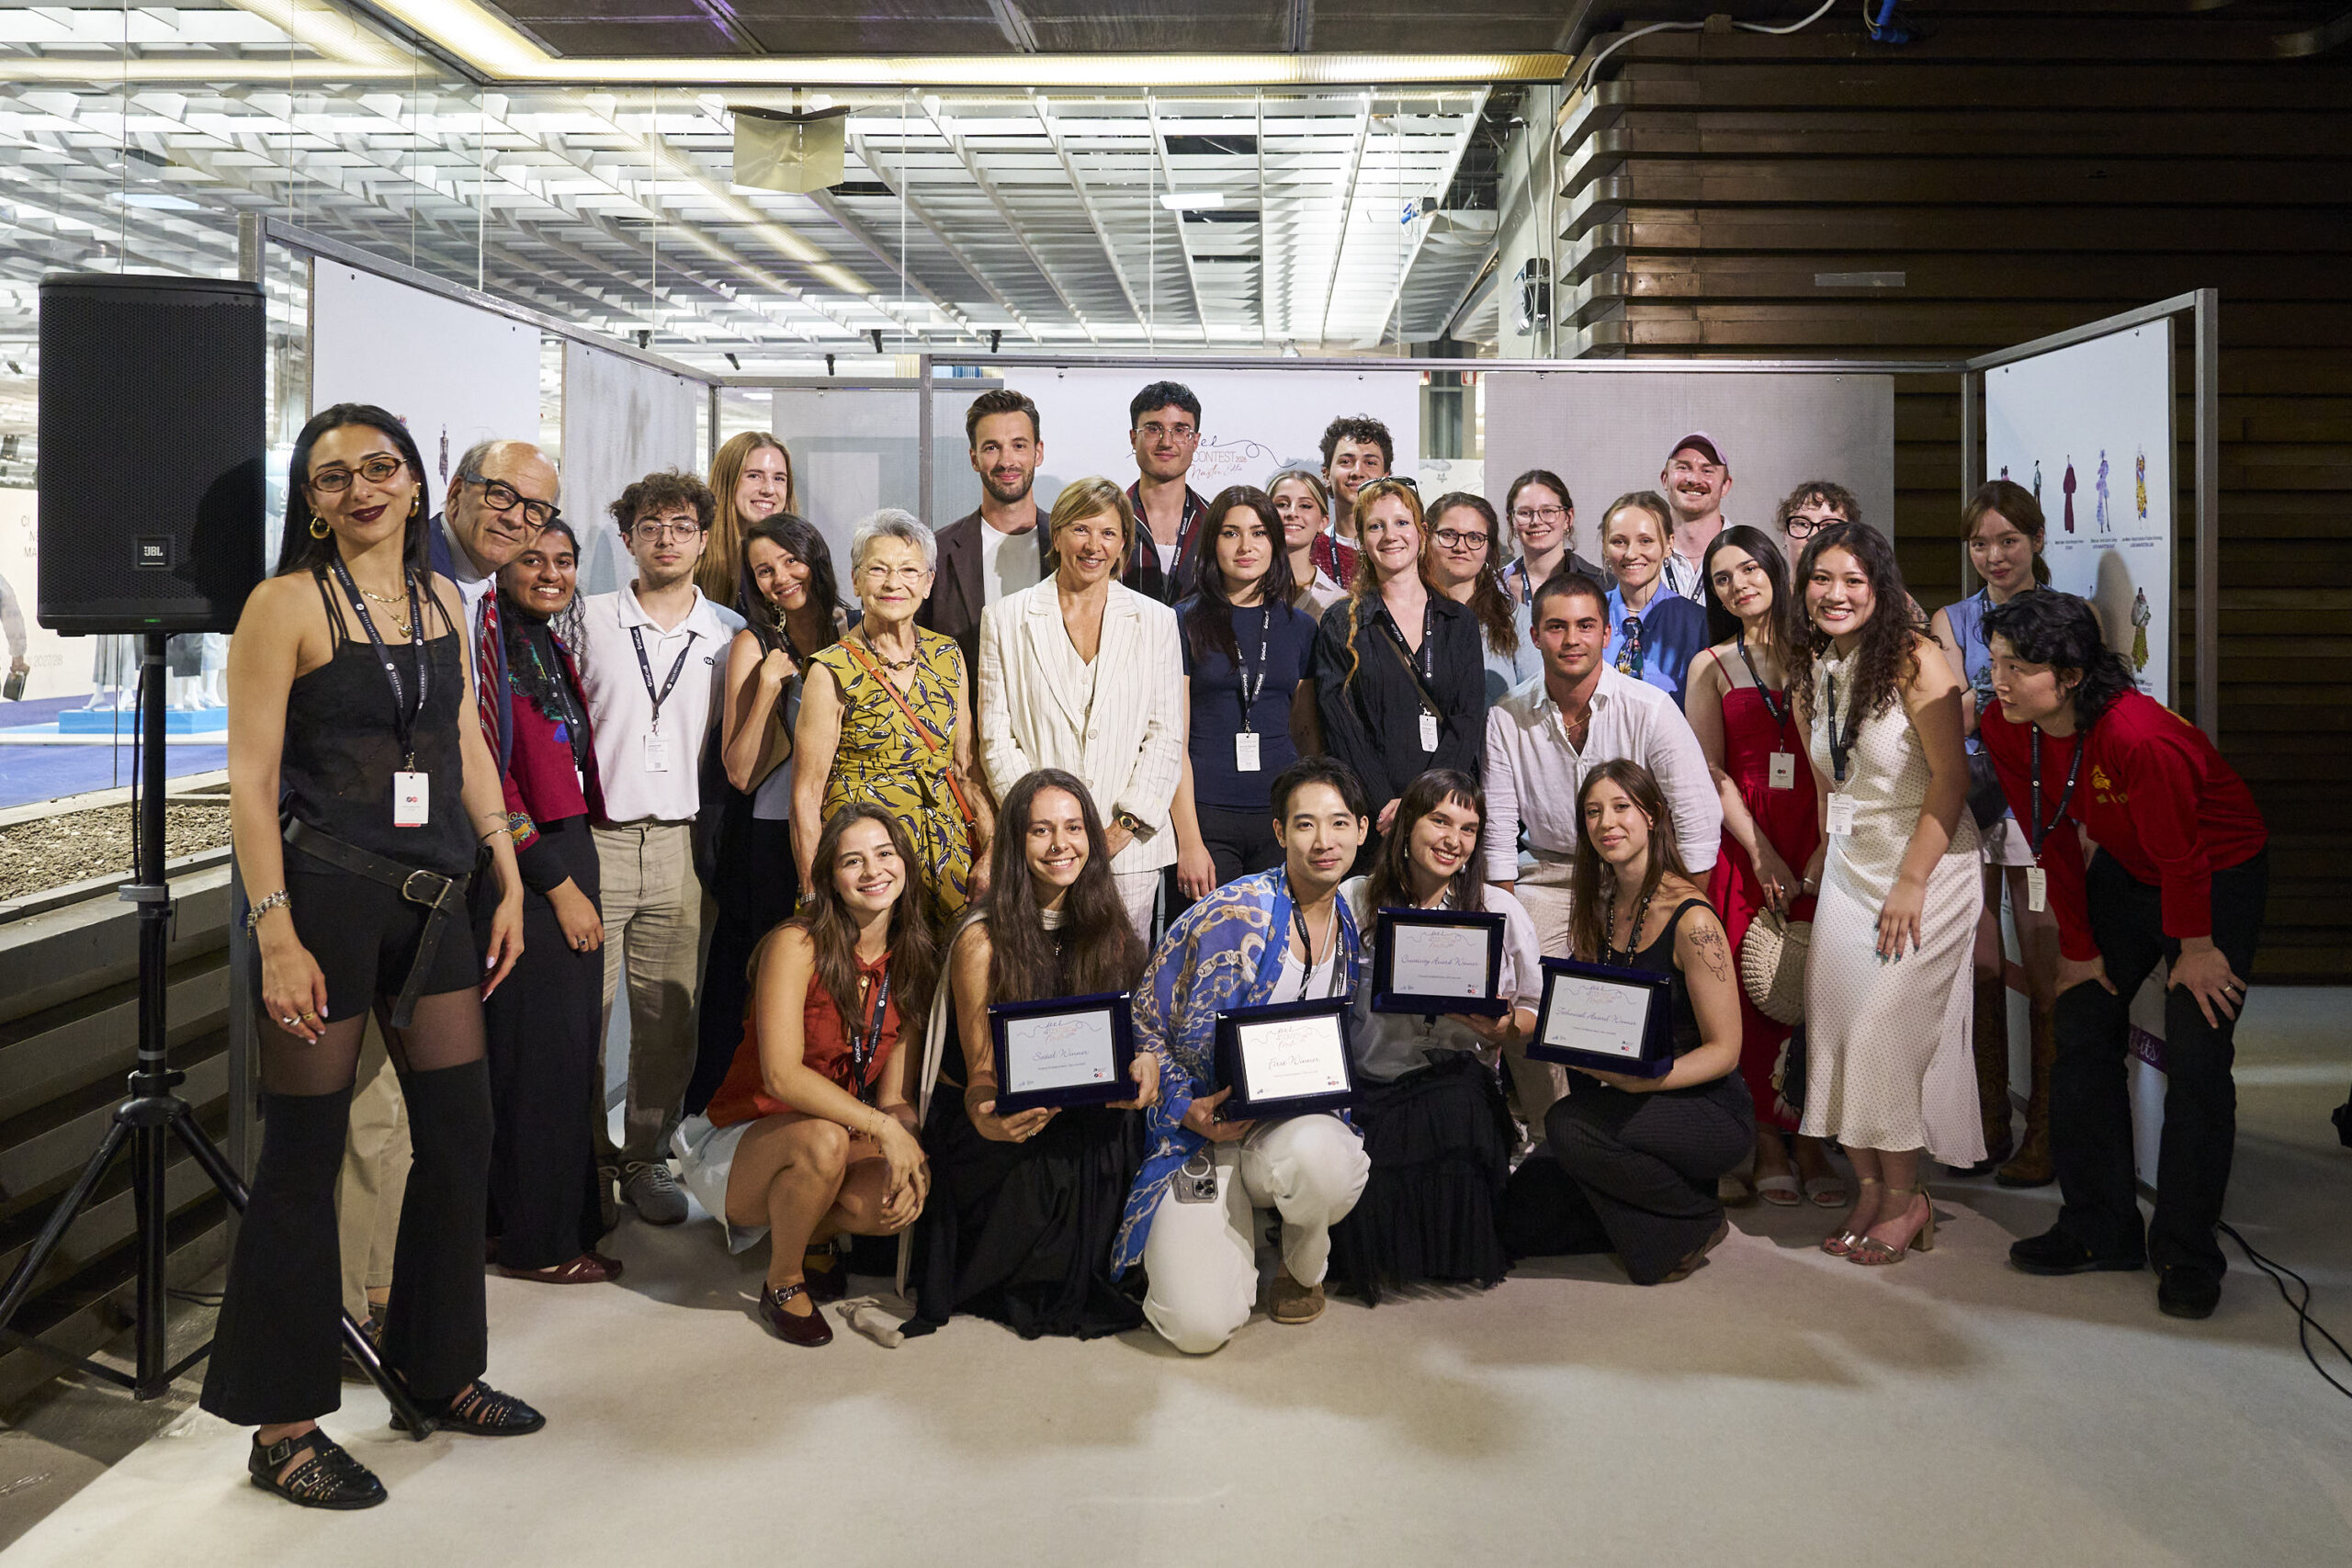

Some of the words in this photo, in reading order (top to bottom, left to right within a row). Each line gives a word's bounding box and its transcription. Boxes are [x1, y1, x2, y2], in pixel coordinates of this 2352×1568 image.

[1193, 451, 1237, 463] CONTEST
[143, 546, 164, 557] JBL
[1033, 1051, 1057, 1062] Social
[1059, 1048, 1090, 1058] Winner
[1288, 1055, 1319, 1066] Winner
